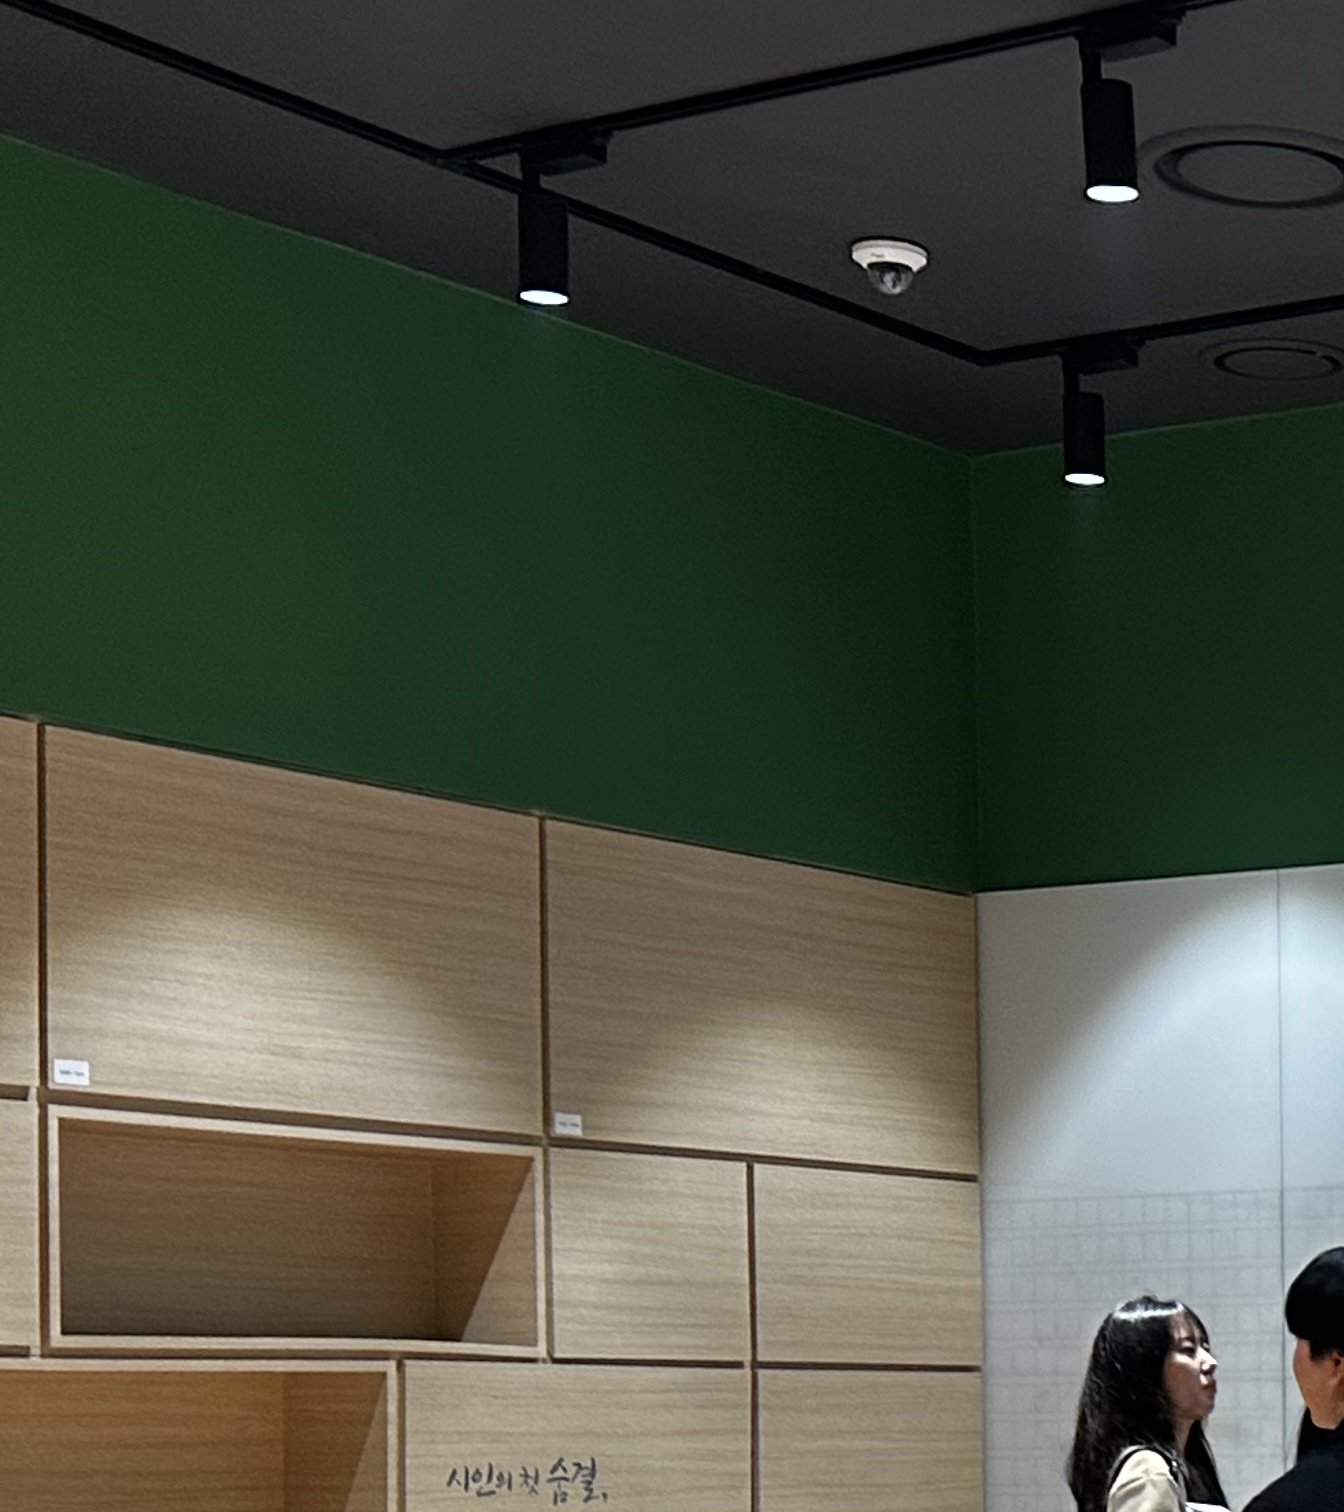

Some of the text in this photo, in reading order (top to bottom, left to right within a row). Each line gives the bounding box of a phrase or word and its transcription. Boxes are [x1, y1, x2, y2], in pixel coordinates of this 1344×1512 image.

[446, 1456, 609, 1507] 시인의 첫 숨결,
